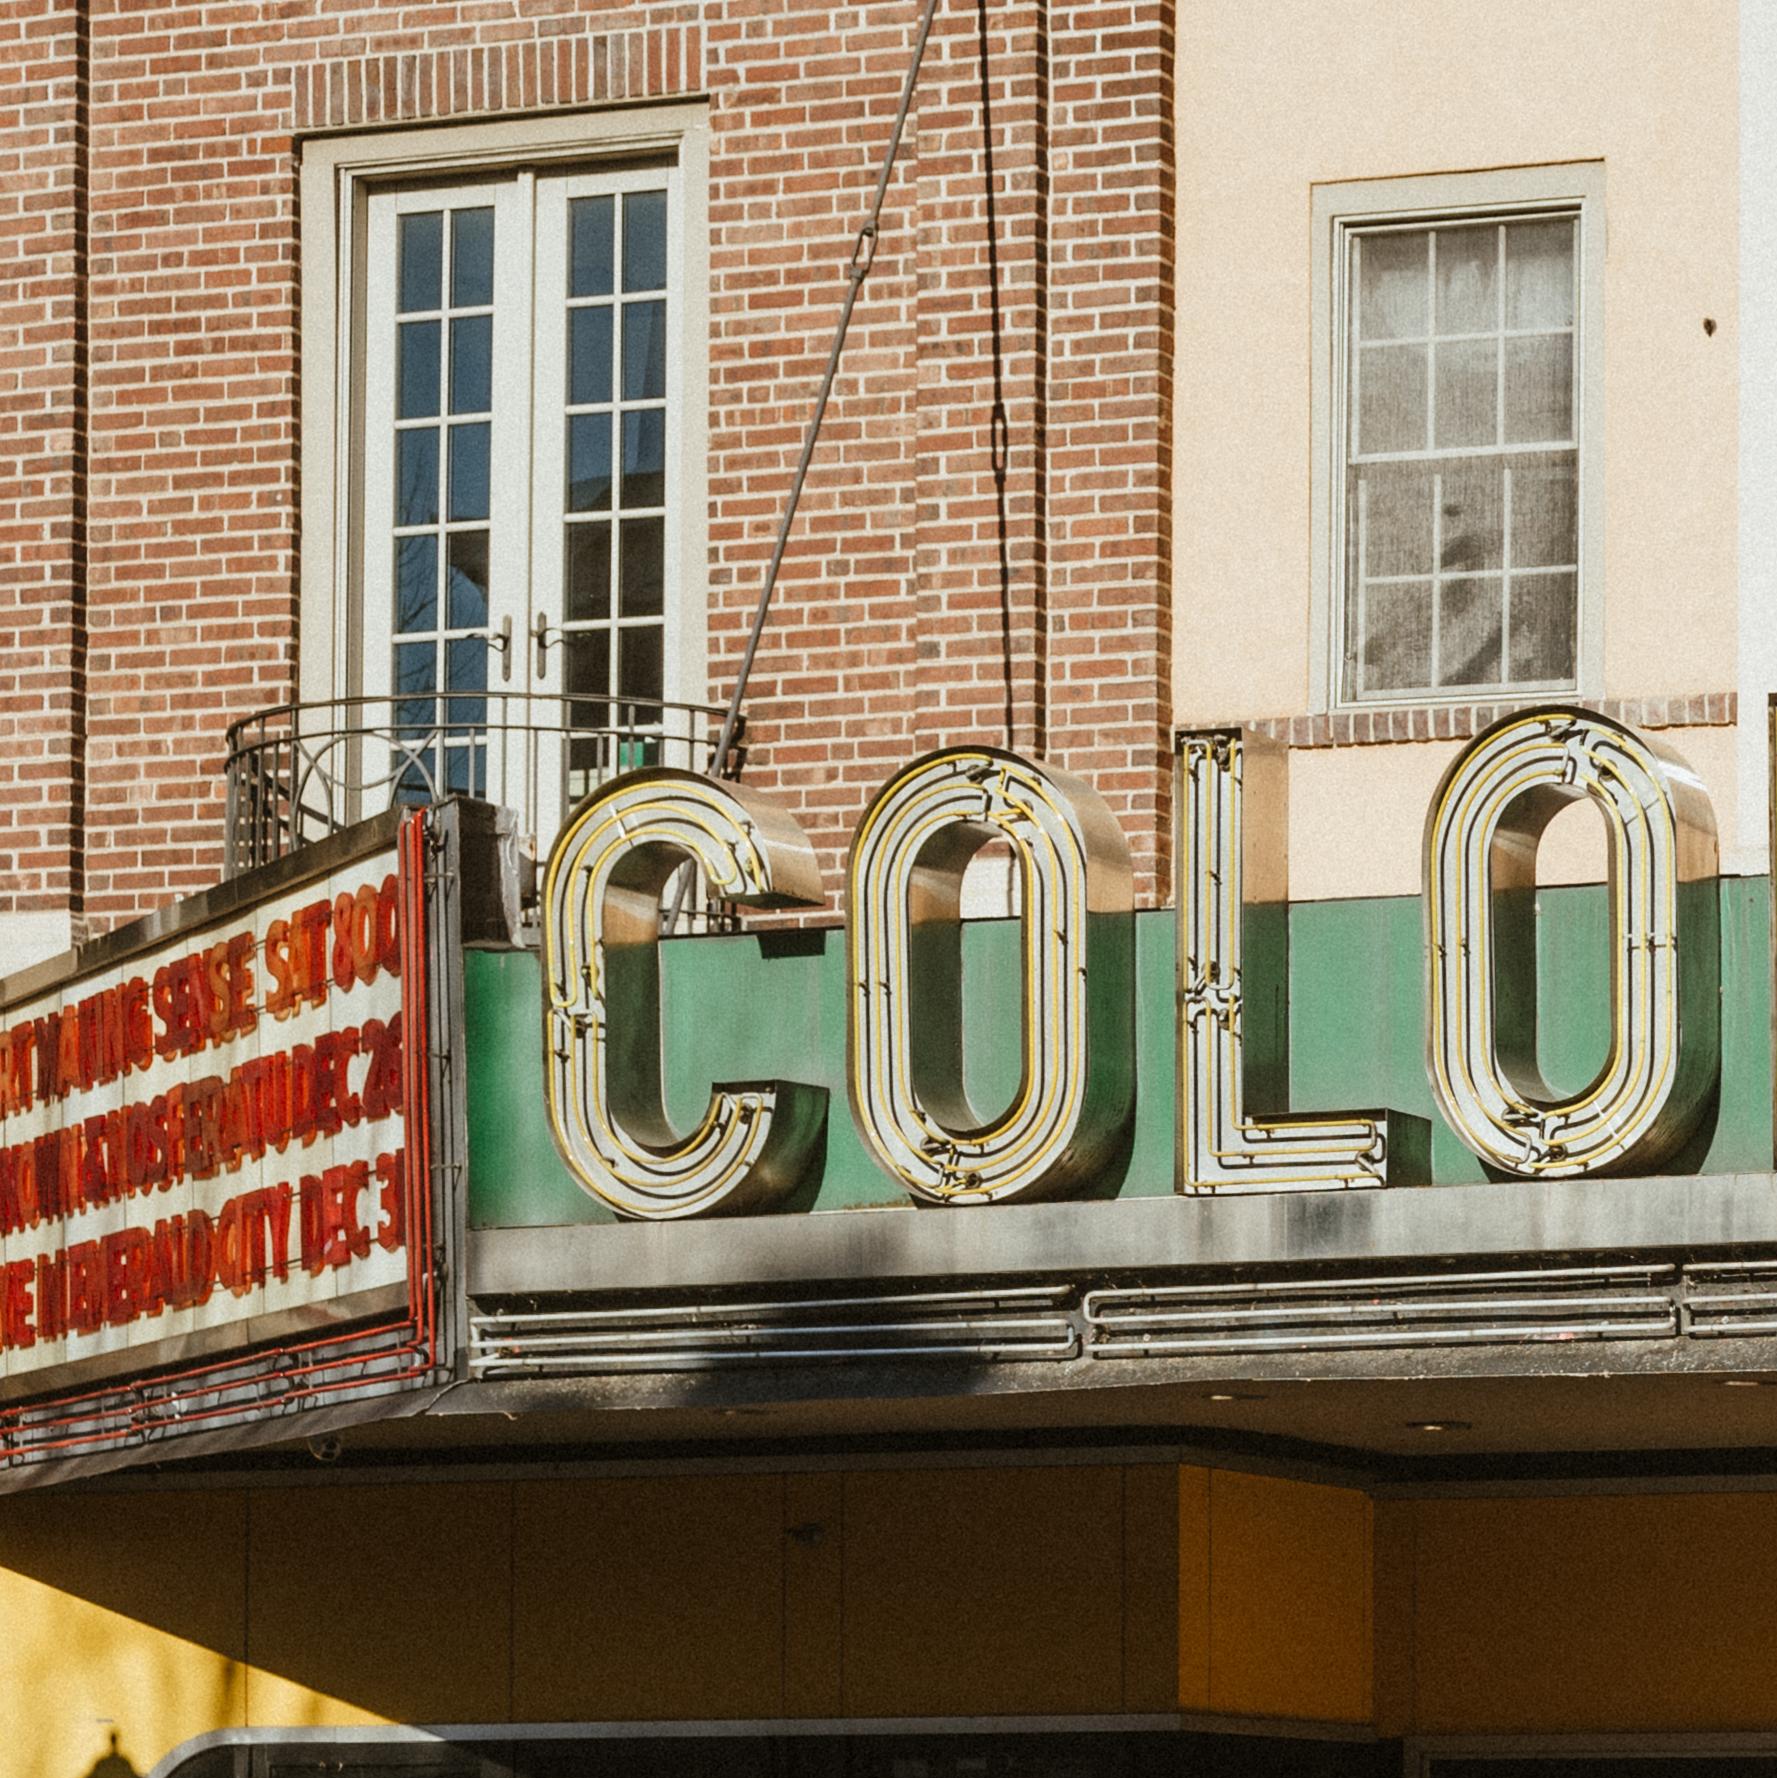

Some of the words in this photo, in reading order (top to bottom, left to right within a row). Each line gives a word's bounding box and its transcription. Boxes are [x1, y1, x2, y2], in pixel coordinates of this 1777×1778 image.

[153, 931, 257, 1062] SENSE
[265, 898, 332, 1022] SAT
[107, 1051, 293, 1200] NOSFERATU
[291, 1026, 361, 1149] DEC
[67, 1208, 217, 1338] EMERALD
[216, 1181, 293, 1297] CITY
[300, 1160, 371, 1279] DEC
